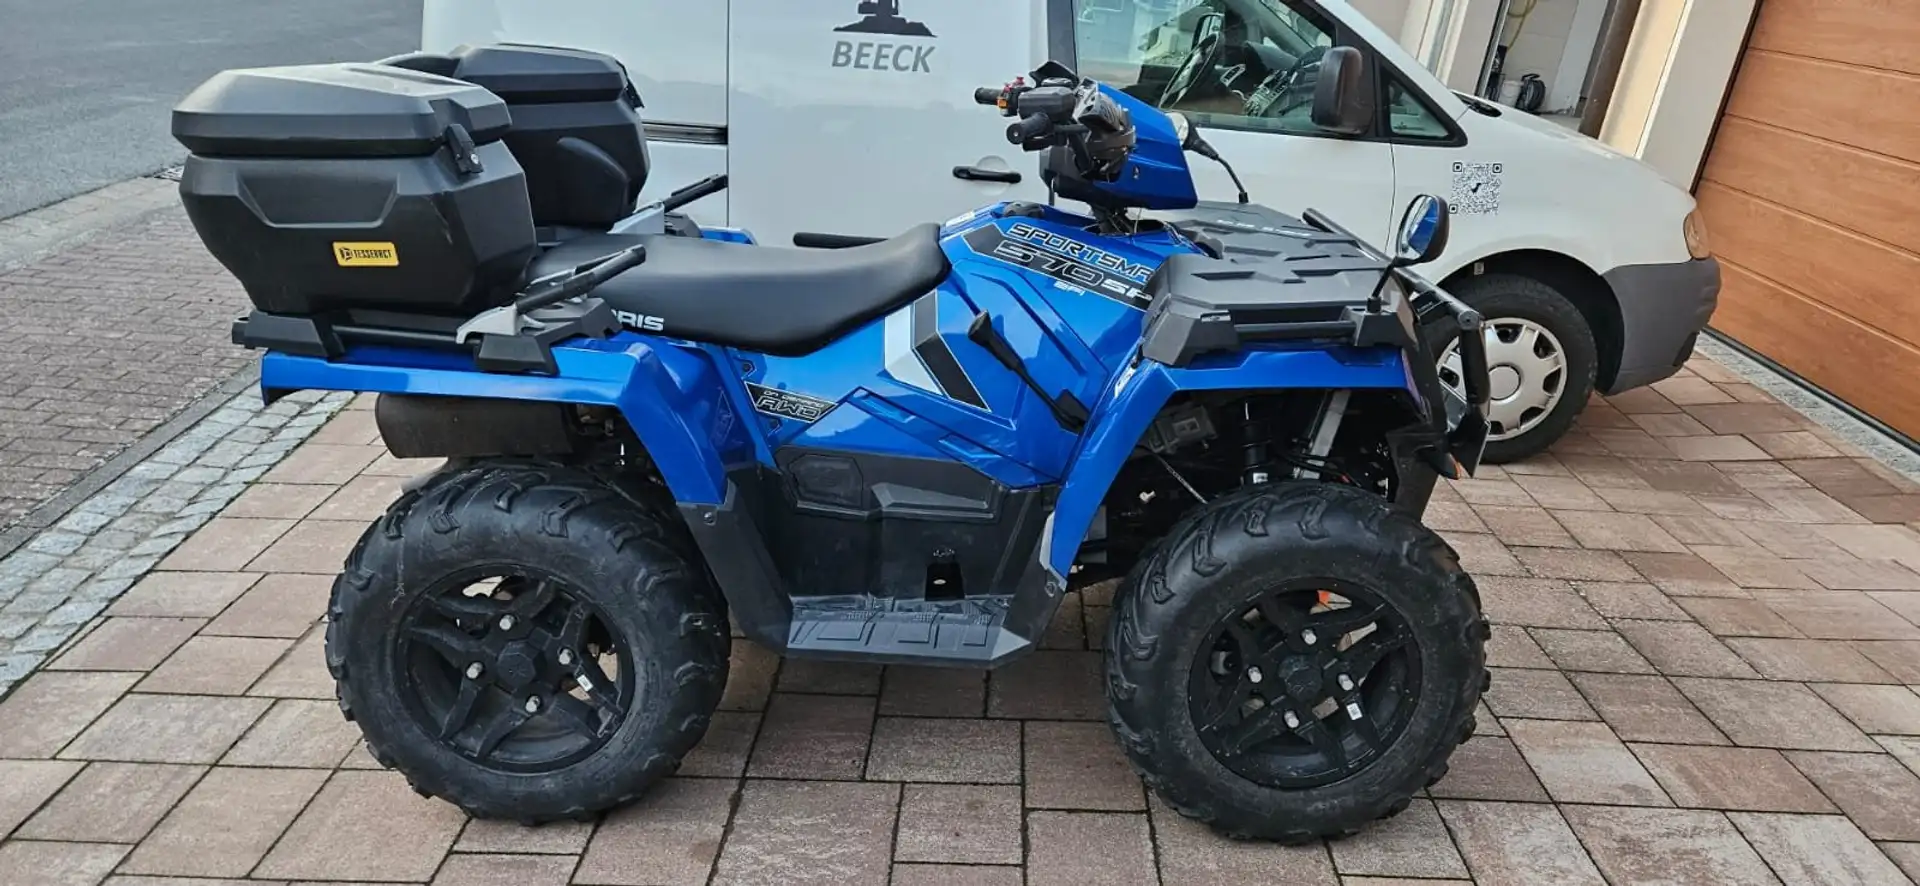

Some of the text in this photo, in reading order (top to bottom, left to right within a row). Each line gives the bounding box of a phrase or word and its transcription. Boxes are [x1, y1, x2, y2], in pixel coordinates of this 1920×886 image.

[831, 40, 936, 73] BEECK
[994, 238, 1104, 287] 570
[1006, 222, 1157, 283] SPORTSMA
[610, 308, 665, 332] RIS
[756, 395, 821, 420] AWD
